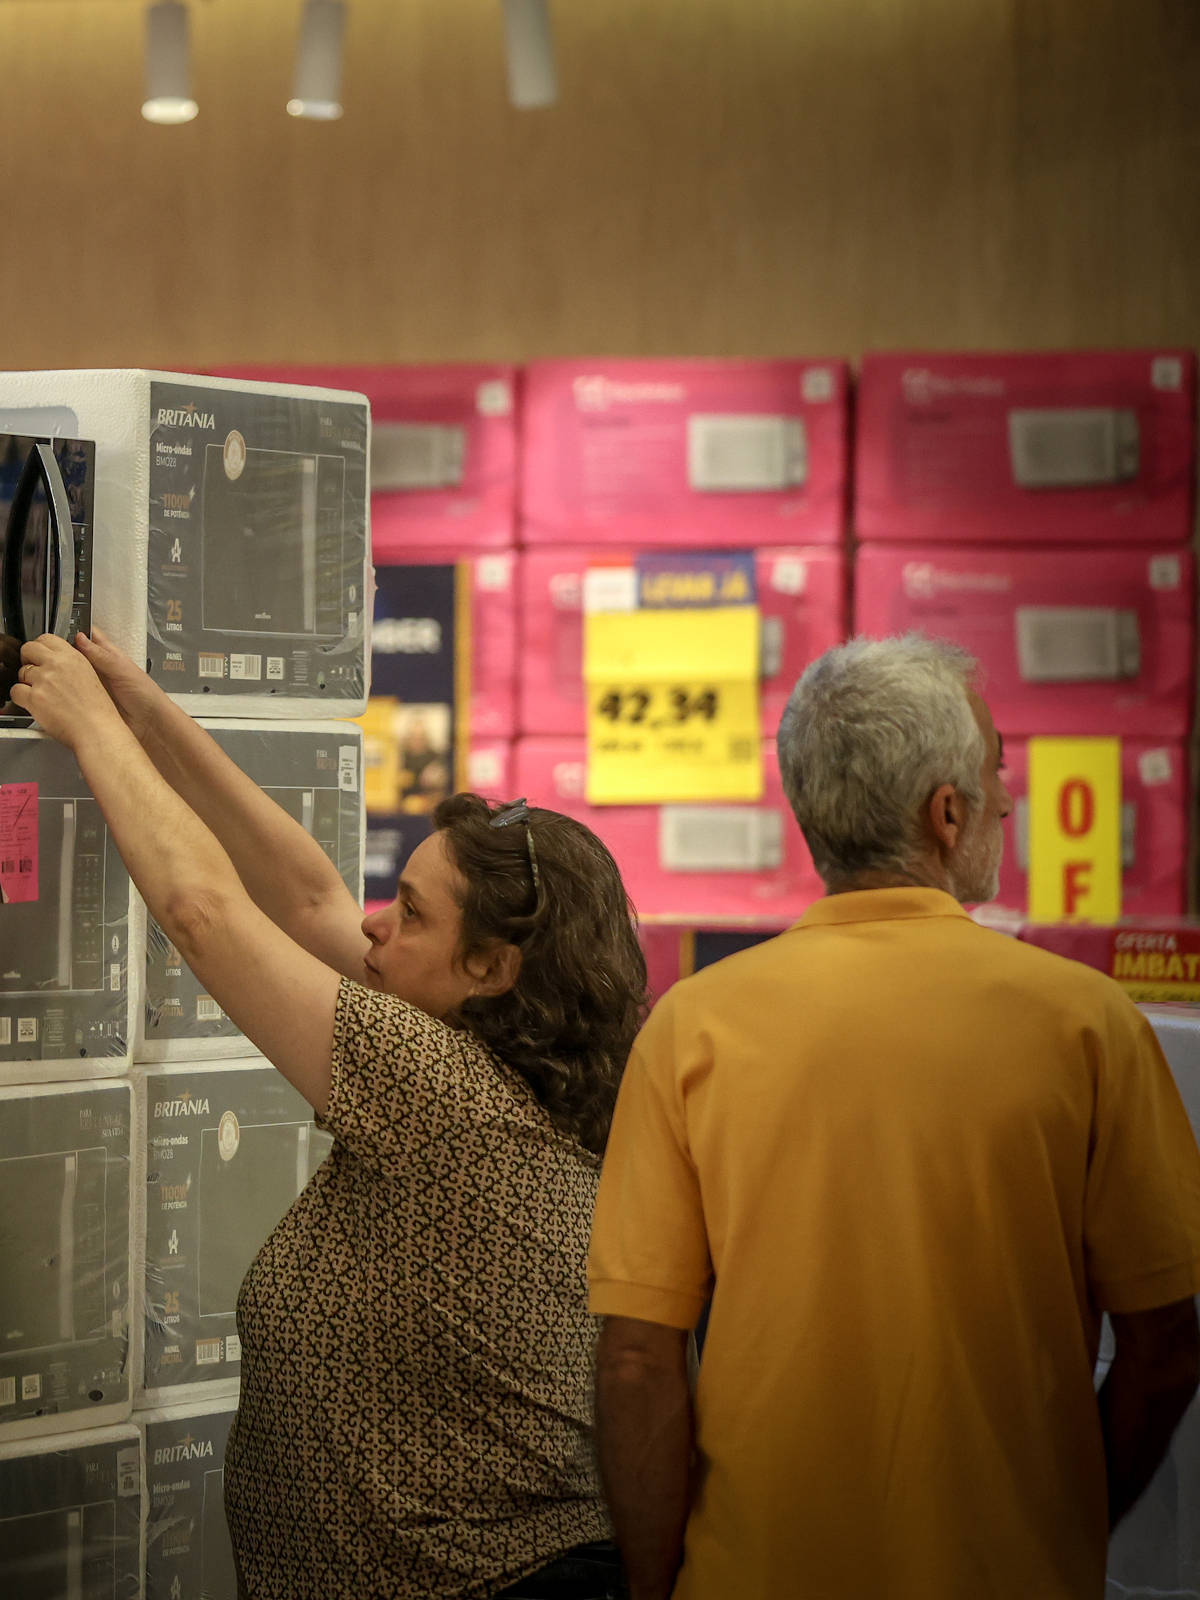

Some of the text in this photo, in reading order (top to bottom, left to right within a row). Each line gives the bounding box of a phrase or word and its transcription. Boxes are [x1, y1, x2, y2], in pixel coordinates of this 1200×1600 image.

[157, 408, 215, 430] BRITANIA
[156, 441, 192, 456] Micro-ondas
[167, 600, 183, 622] 25
[166, 623, 183, 631] LITROS
[598, 684, 719, 730] 42,34
[1114, 931, 1178, 953] OFERTA
[154, 1098, 210, 1118] BRITANIA
[154, 1440, 213, 1465] BRITANIA
